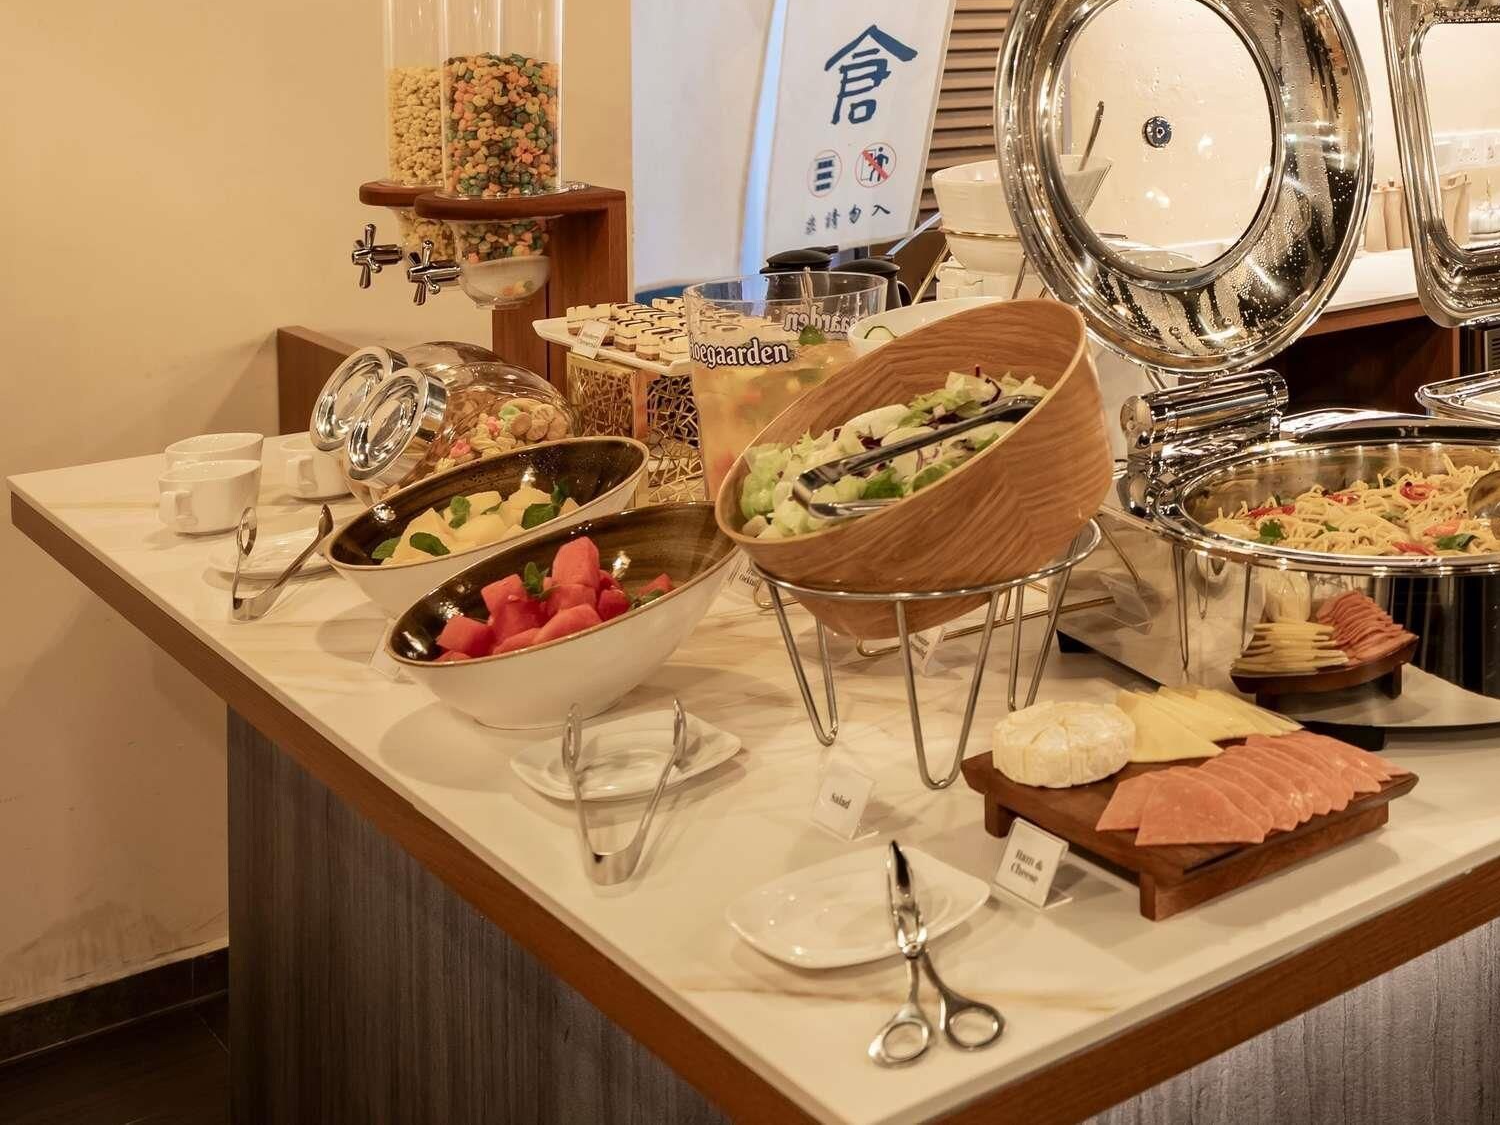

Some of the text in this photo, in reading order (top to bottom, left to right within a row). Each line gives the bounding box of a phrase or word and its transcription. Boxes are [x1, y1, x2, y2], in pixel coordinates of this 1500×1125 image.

[823, 24, 919, 125] 倉
[830, 792, 852, 809] Salad
[1015, 848, 1044, 872] Ham &
[1009, 862, 1039, 885] Cheese
